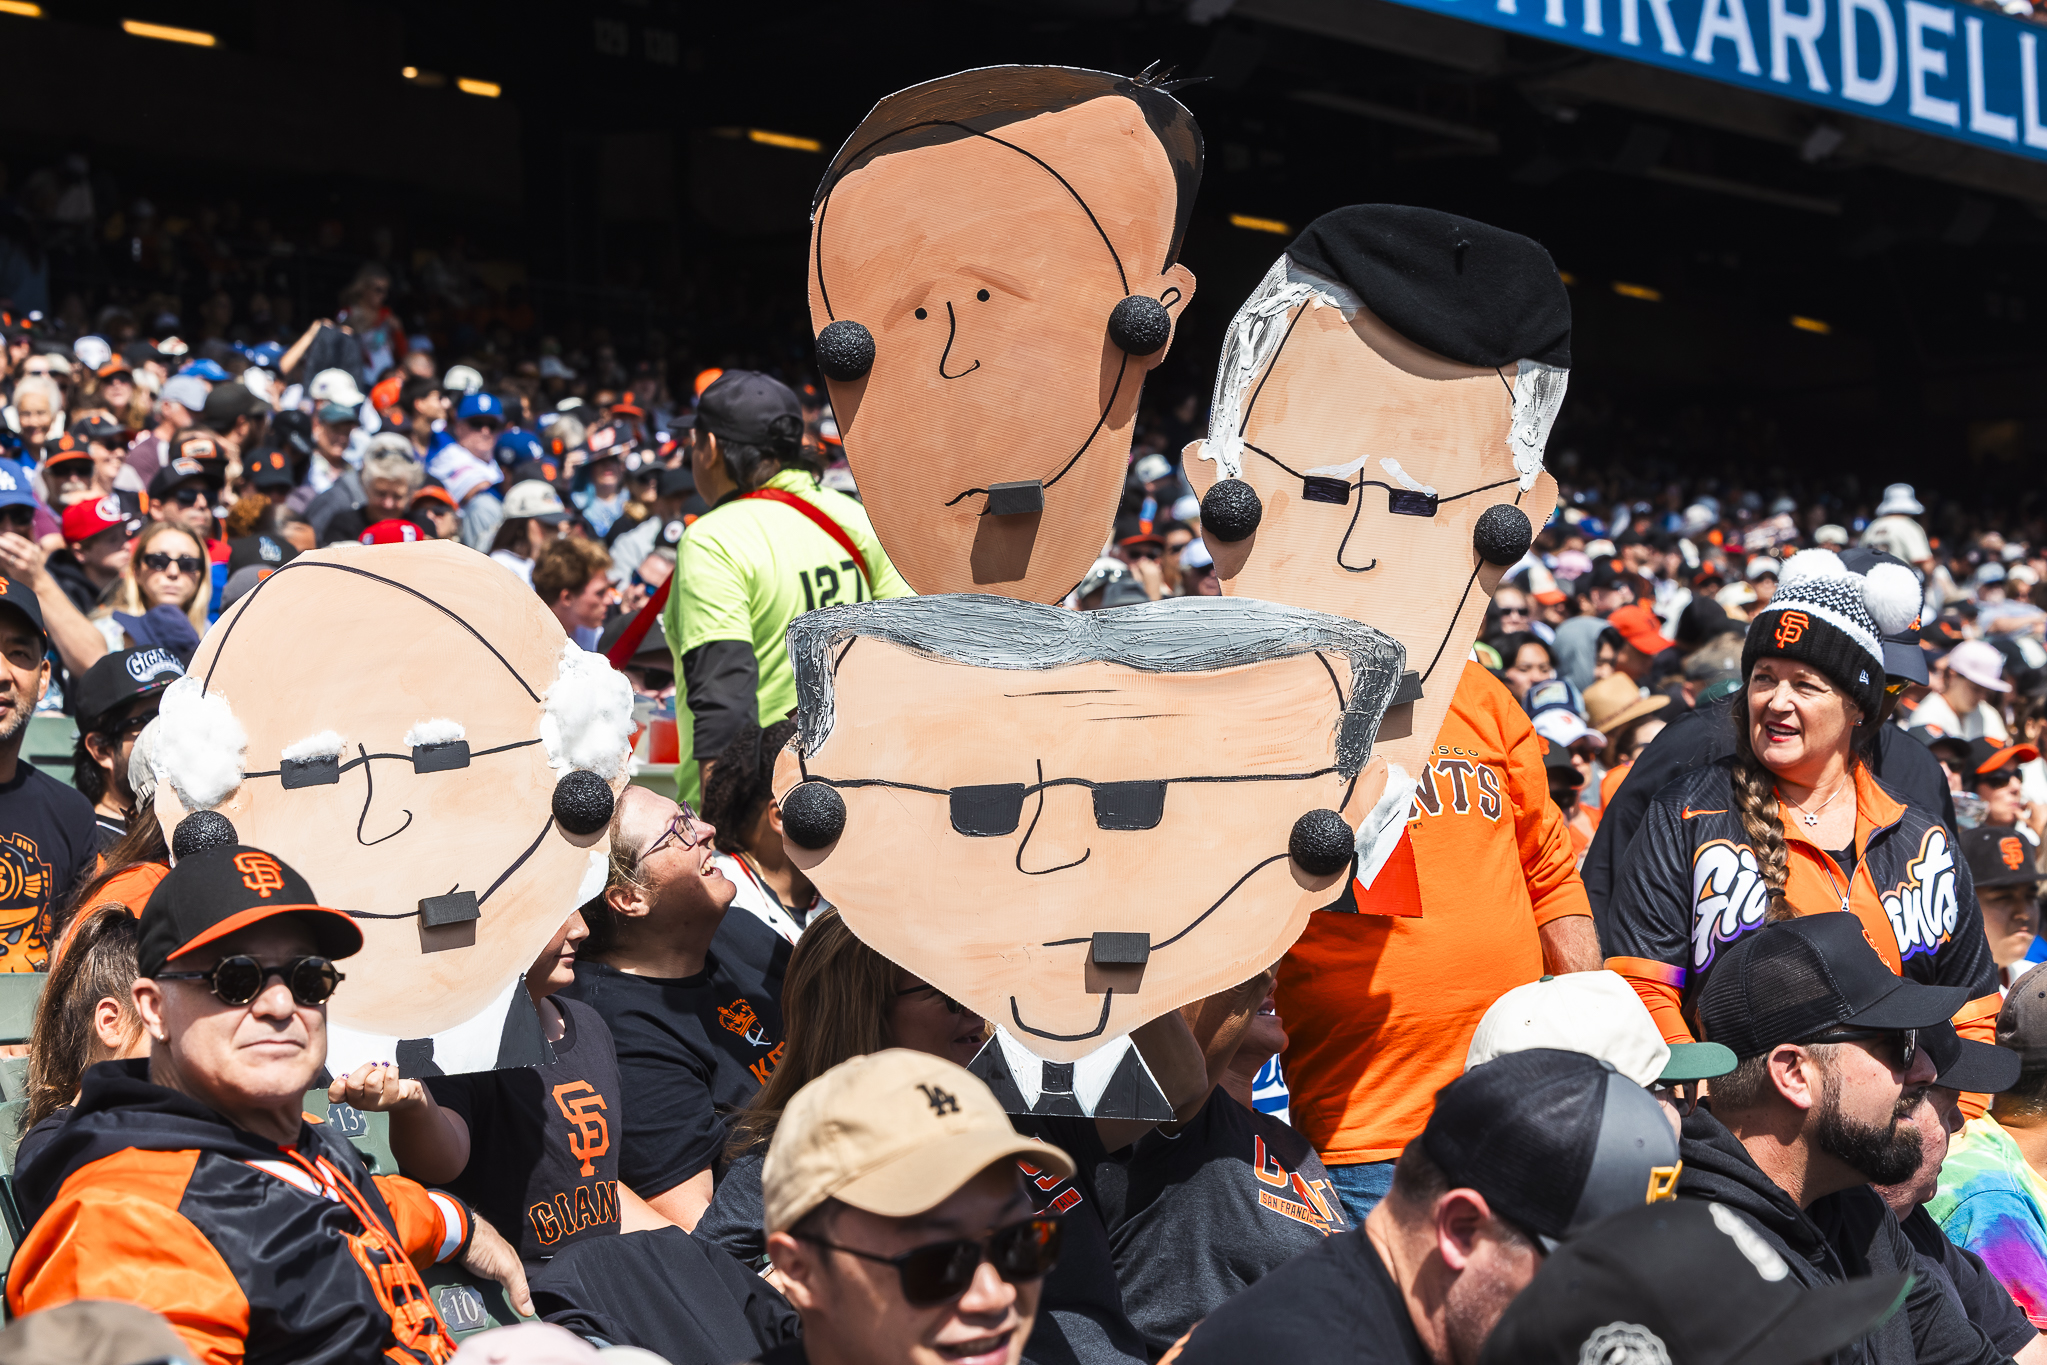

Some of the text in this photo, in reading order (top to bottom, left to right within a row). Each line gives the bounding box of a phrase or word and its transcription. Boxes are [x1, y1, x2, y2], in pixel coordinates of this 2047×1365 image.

[799, 559, 864, 611] 127
[1774, 610, 1810, 650] SF
[2000, 836, 2026, 871] SF
[233, 852, 286, 898] SF
[335, 1105, 360, 1132] 13
[915, 1084, 960, 1117] LA
[552, 1079, 611, 1177] SF
[528, 1179, 622, 1245] GIAN
[1280, 1200, 1318, 1225] FRANCIS
[450, 1291, 479, 1324] 10
